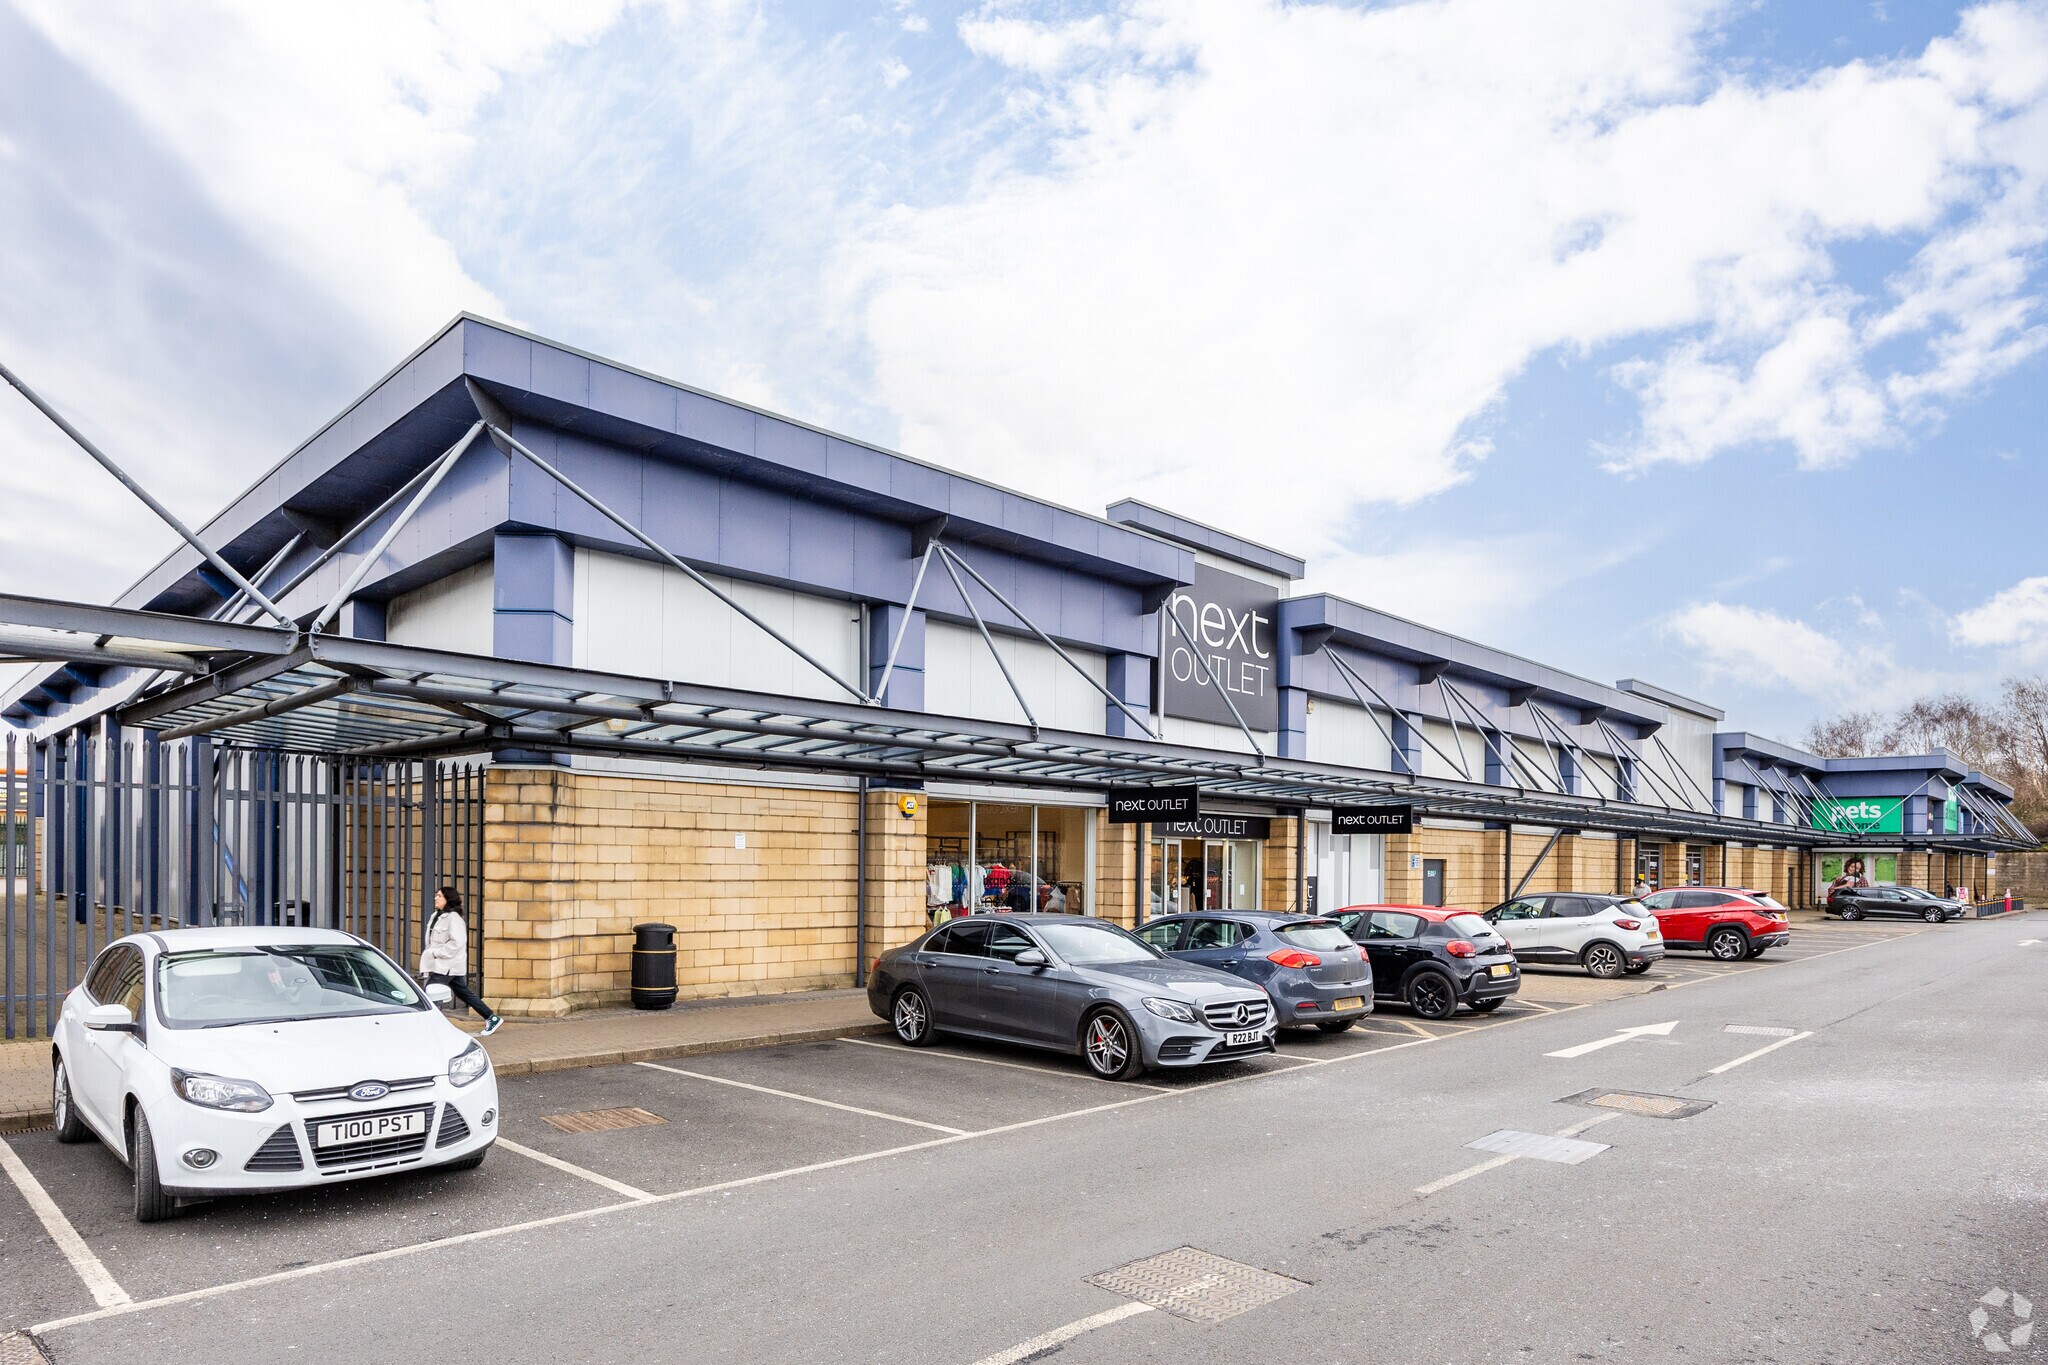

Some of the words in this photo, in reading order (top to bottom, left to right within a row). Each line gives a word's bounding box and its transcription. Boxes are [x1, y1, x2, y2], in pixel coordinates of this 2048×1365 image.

[1172, 593, 1269, 659] next
[1171, 647, 1269, 696] OUTLET
[1115, 799, 1145, 811] next
[1147, 798, 1188, 810] OUTLET
[1831, 802, 1881, 823] pets
[1204, 817, 1247, 834] OUTLET
[1338, 815, 1365, 824] next
[1367, 815, 1404, 824] OUTLET
[1233, 1033, 1246, 1044] R22
[1247, 1031, 1258, 1041] BJT
[360, 1087, 381, 1097] Ford
[332, 1120, 372, 1140] T100
[379, 1115, 413, 1134] PST
